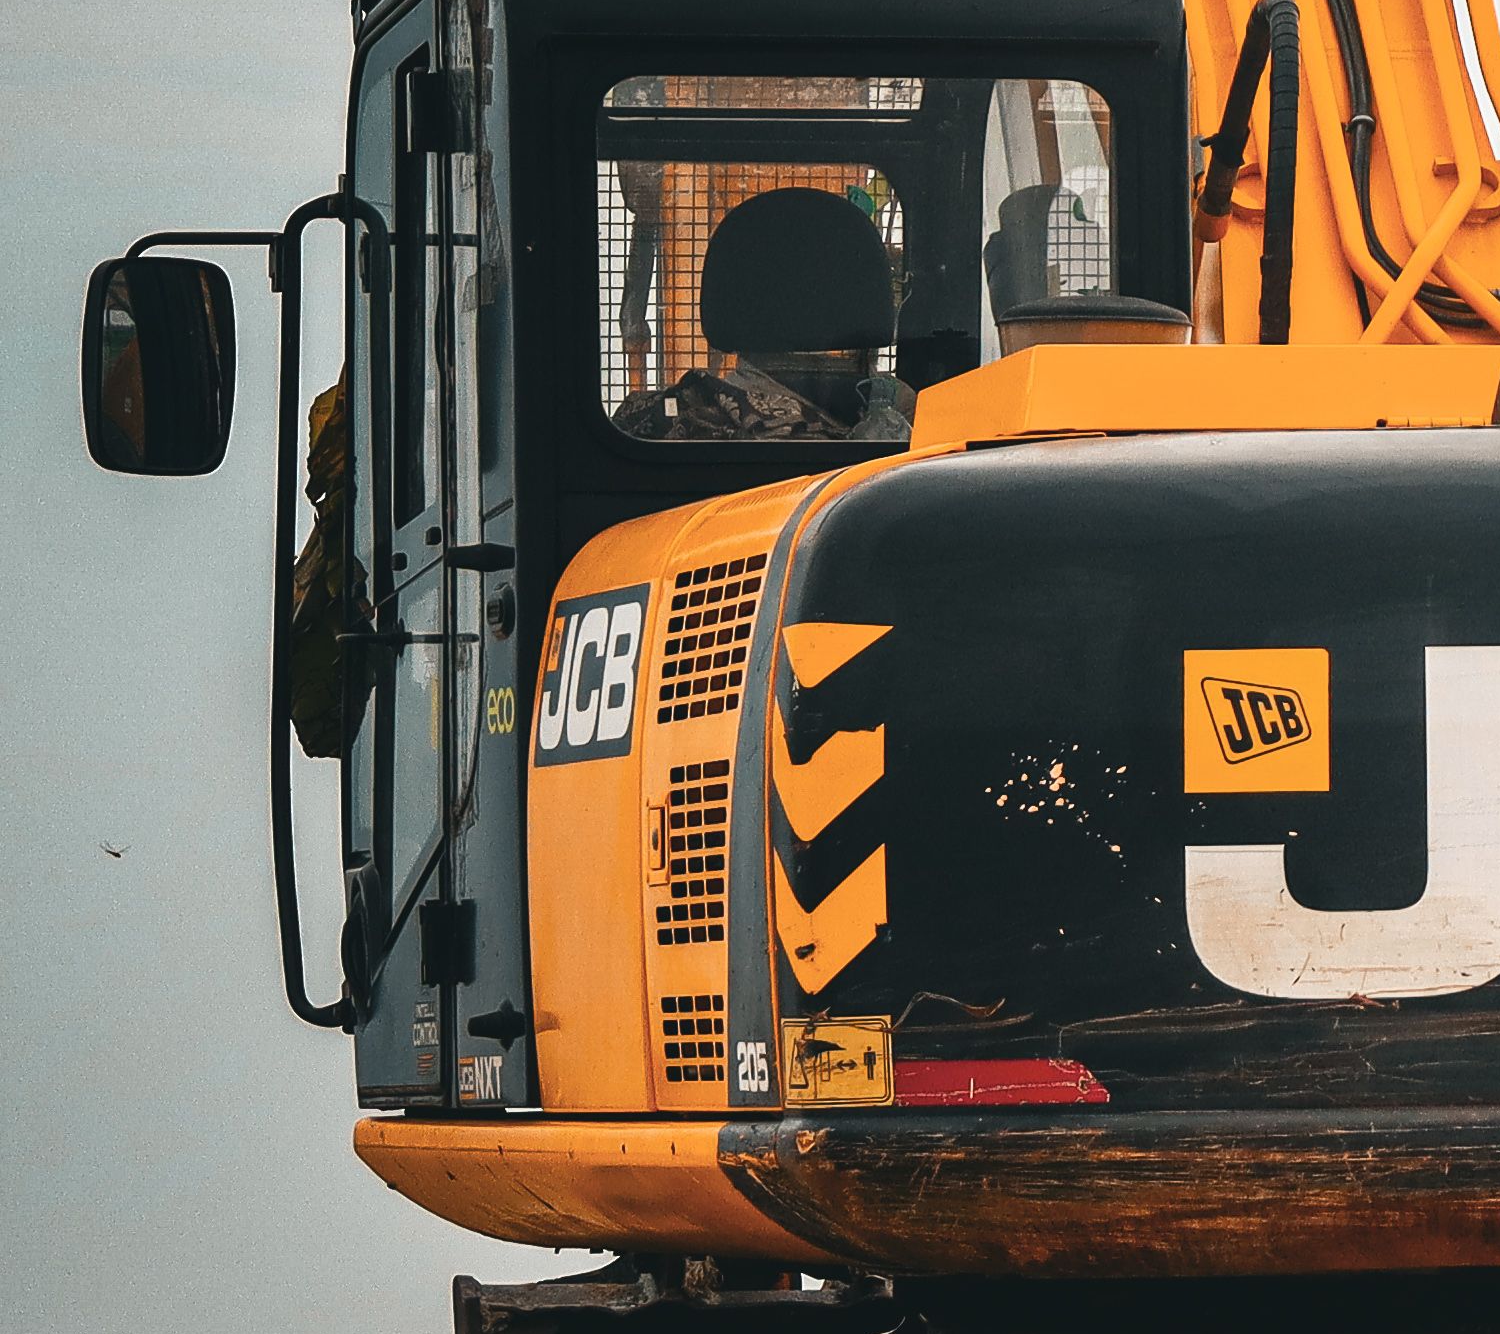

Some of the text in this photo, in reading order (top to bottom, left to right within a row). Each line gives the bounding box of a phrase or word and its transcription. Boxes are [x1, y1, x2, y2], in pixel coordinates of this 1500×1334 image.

[538, 601, 642, 750] JCB
[486, 686, 516, 735] eco
[1221, 687, 1304, 754] JCB
[474, 1055, 503, 1100] NXT
[736, 1041, 770, 1093] 205
